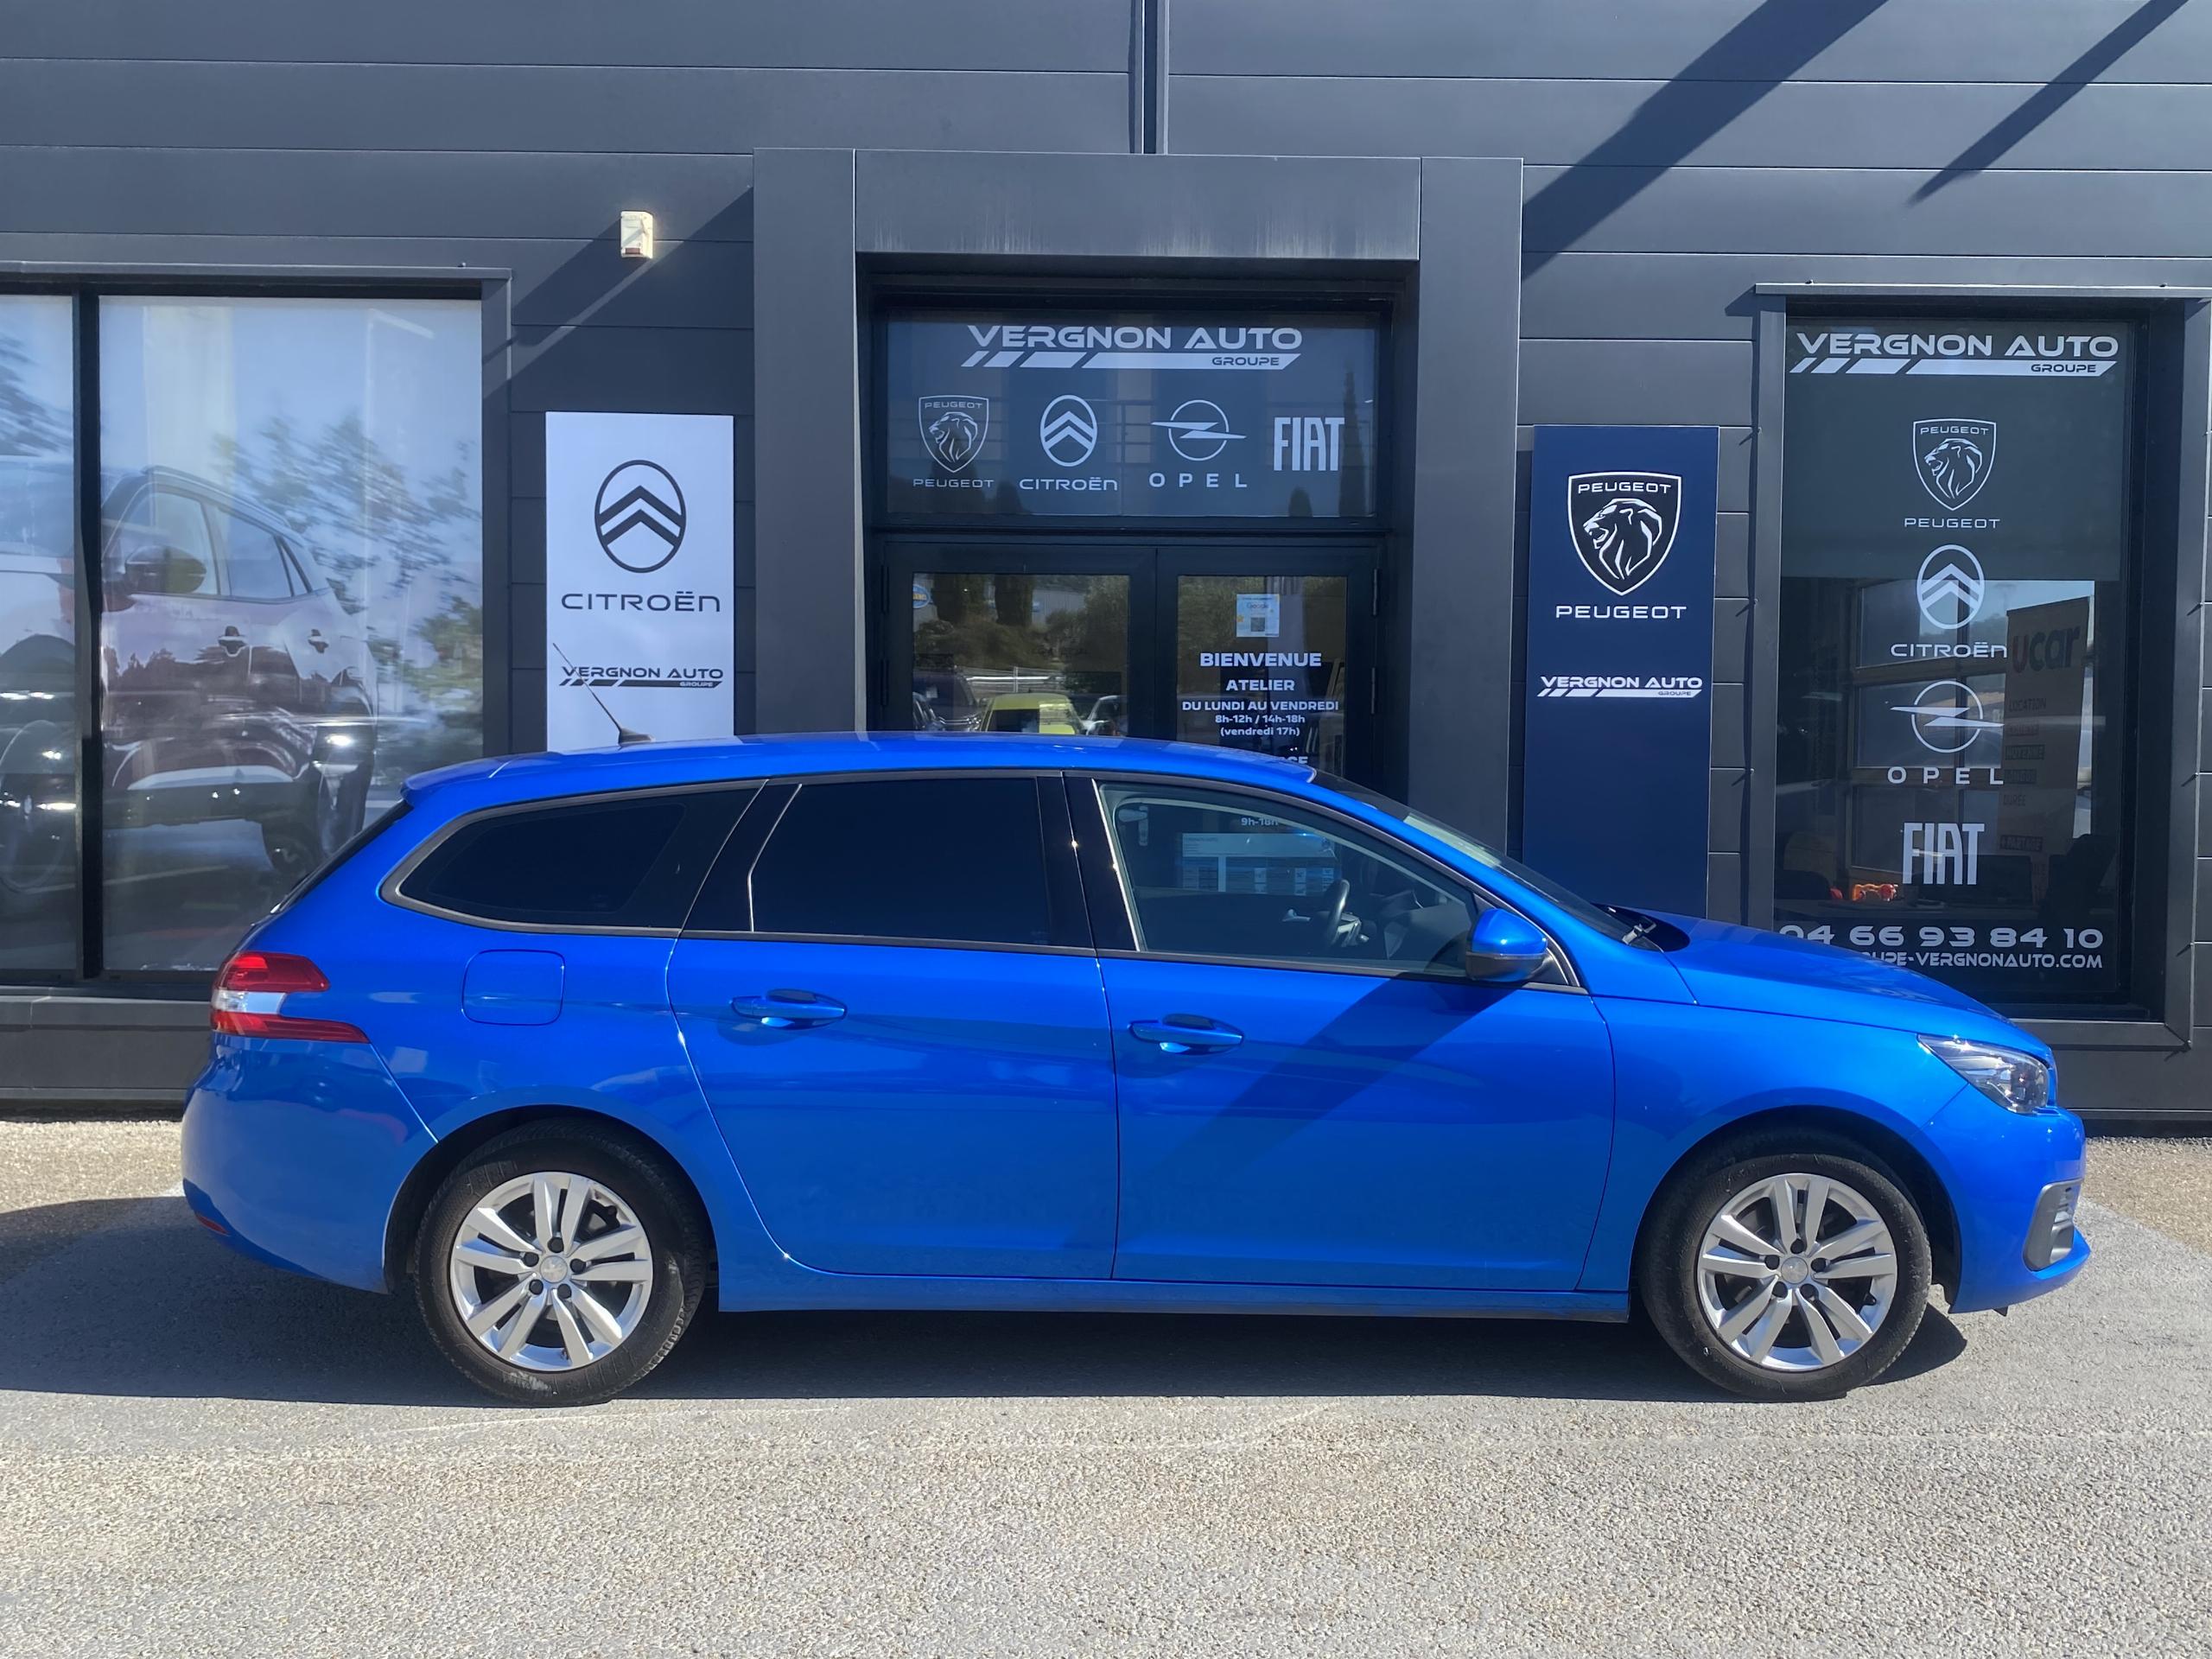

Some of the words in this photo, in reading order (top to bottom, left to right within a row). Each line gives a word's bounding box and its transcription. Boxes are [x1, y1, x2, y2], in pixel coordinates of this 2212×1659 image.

[967, 325, 1172, 349] VERGNON
[1184, 327, 1302, 349] AUTO
[1796, 333, 1993, 356] VERGNON
[2004, 335, 2119, 357] AUTO
[1211, 356, 1280, 367] GROUPE
[2031, 363, 2096, 373] GROUPE
[924, 400, 983, 410] PEUGEOT
[1920, 426, 1989, 435] PEUGEOT
[1273, 417, 1345, 472] FIAT
[912, 479, 995, 488] PEUGEOT
[1148, 473, 1248, 488] OPEL
[1577, 481, 1672, 494] PEUGEOT
[1904, 518, 2001, 529] PEUGEOT
[1555, 606, 1687, 619] PEUGEOT
[1200, 653, 1322, 667] BIENVENUE
[561, 666, 661, 679] VERGNON
[666, 668, 724, 680] AUTO
[1225, 680, 1295, 691] ATELIER
[1540, 676, 1640, 690] VERGNON
[1643, 677, 1702, 690] AUTO
[1182, 702, 1201, 711] DU
[1205, 702, 1245, 711] LUNDI
[1248, 702, 1268, 711] AU
[1270, 702, 1338, 711] VENDREDI
[1215, 715, 1253, 724] 8h-12h
[1262, 715, 1306, 724] 14h-18h
[1220, 727, 1274, 737] (vendredi
[1276, 727, 1300, 737] 17h)
[1887, 766, 2004, 785] OPEL
[1902, 823, 1985, 885] FIAT
[1849, 926, 1904, 946] 66
[1919, 927, 1975, 947] 93
[1990, 928, 2049, 949] 84
[2063, 929, 2104, 949] 10
